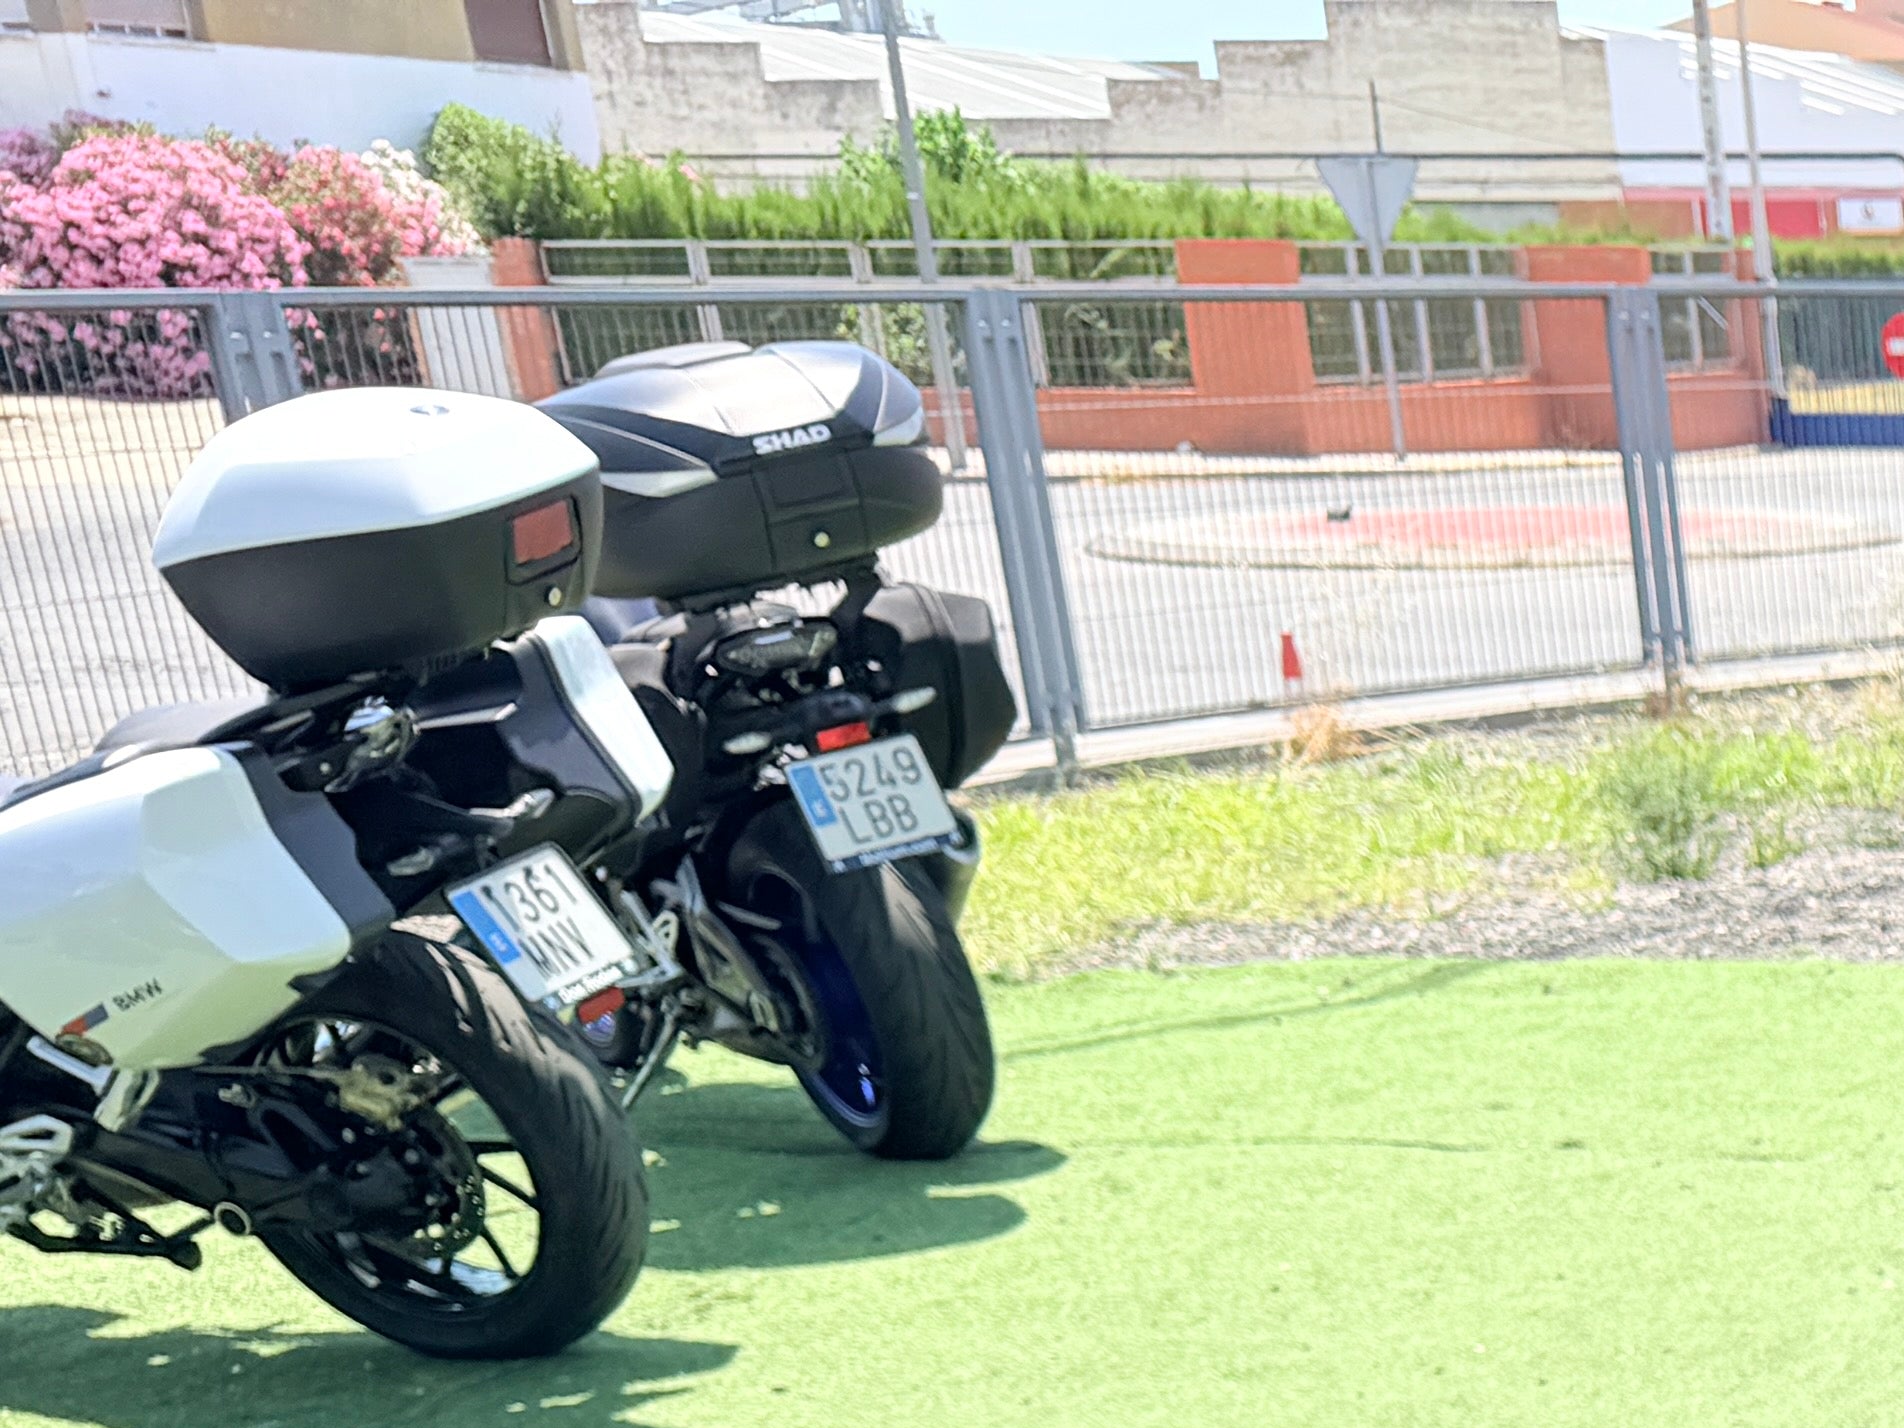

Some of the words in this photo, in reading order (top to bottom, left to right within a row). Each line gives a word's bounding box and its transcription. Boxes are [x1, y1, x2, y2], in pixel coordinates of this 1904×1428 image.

[752, 423, 832, 455] SHAD
[819, 746, 921, 802] 5249
[838, 794, 918, 844] LBB
[480, 864, 577, 932] 1361
[113, 978, 162, 1012] BMW
